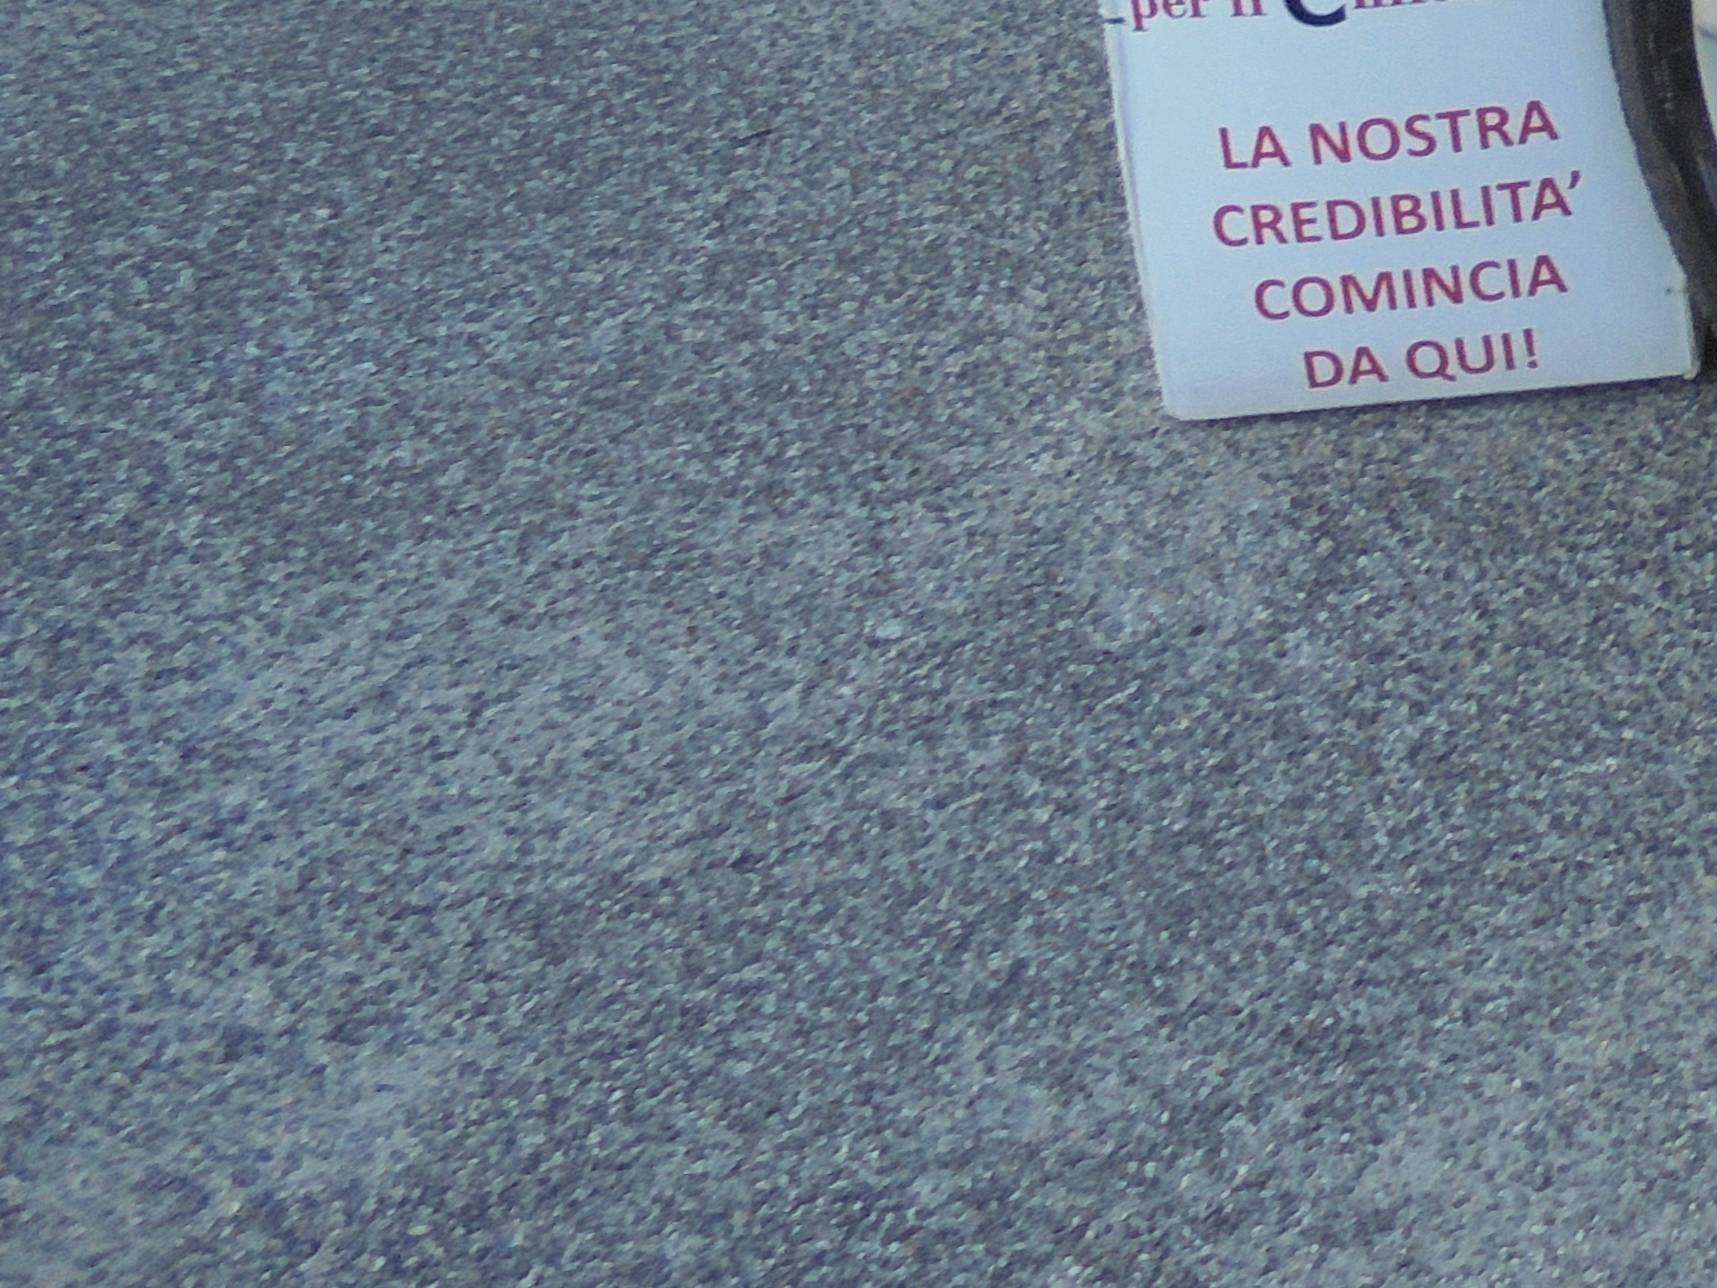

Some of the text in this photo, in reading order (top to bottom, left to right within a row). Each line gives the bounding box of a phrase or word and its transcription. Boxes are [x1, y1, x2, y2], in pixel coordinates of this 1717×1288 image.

[1218, 100, 1559, 170] LA NOSTRA
[1254, 255, 1568, 320] COMINCIA
[1304, 328, 1539, 389] DA QUI!
